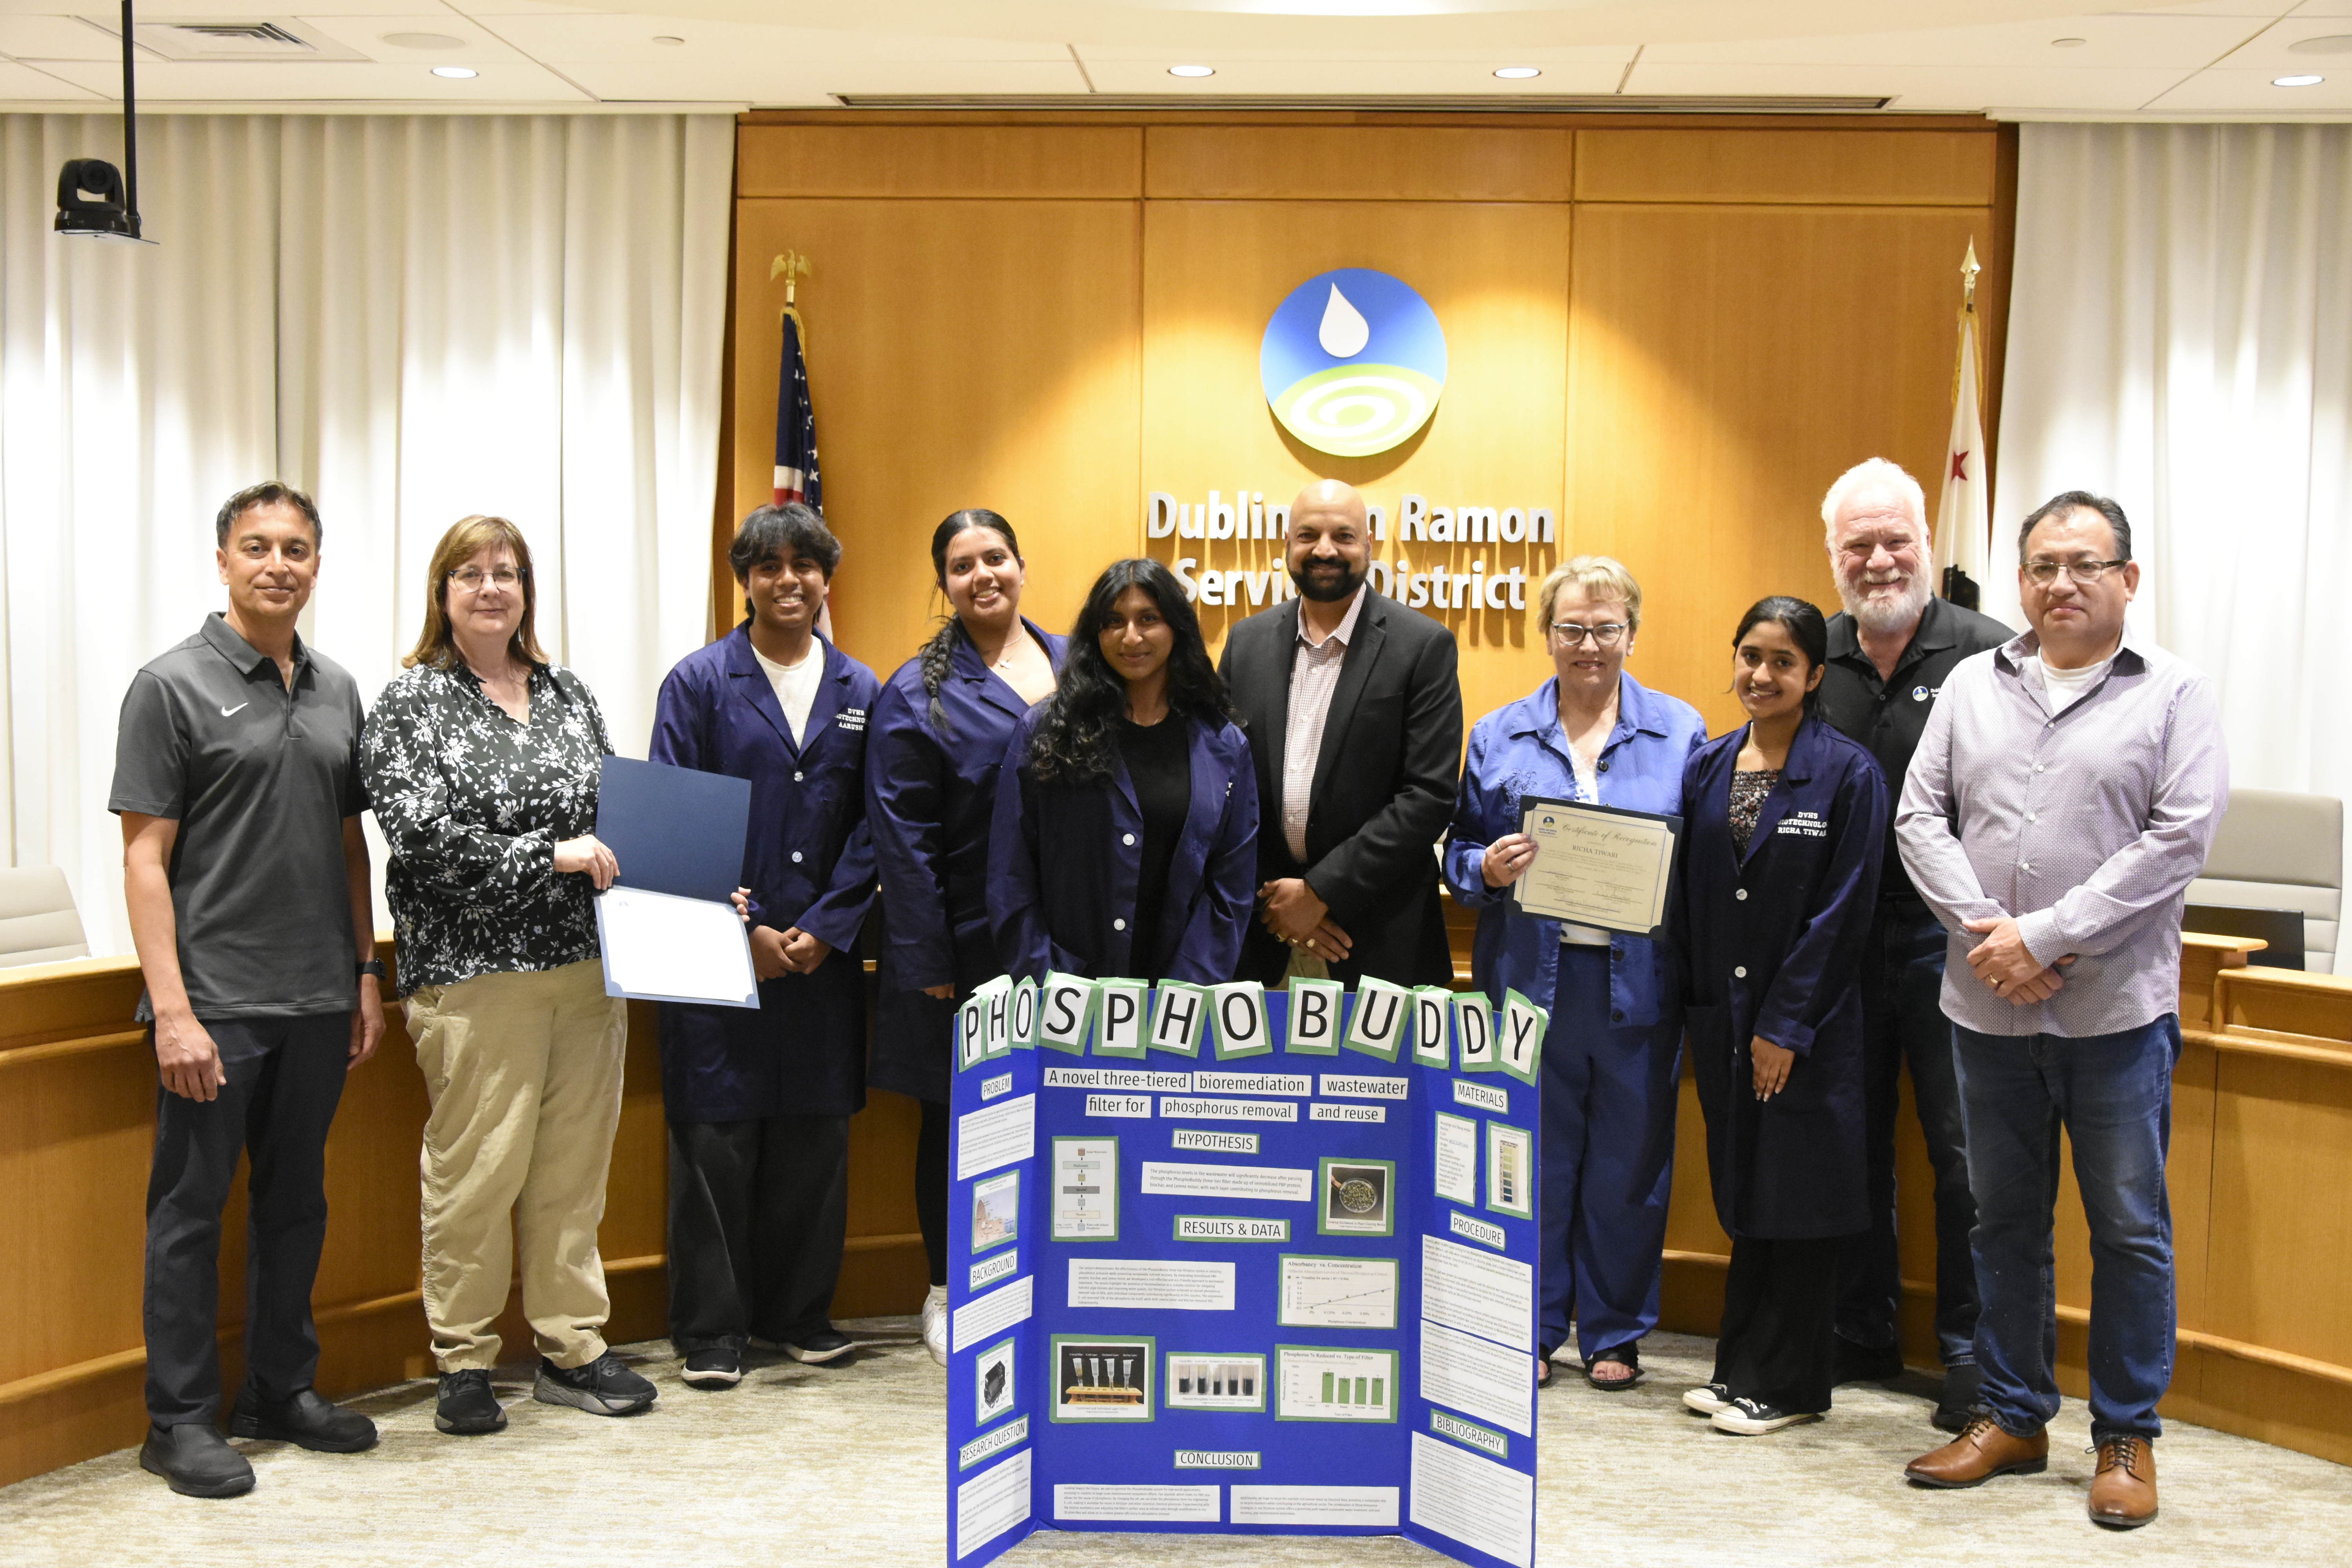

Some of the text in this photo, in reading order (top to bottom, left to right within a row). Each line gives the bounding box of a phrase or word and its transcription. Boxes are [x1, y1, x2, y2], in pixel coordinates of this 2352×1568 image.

[1148, 490, 1290, 539] Dublin
[1401, 494, 1554, 543] Ramon
[1175, 558, 1526, 610] Servi District
[848, 708, 864, 716] DVHS
[838, 721, 863, 731] AARUSH
[1562, 823, 1599, 837] Certificate
[1601, 831, 1612, 841] of
[1611, 833, 1657, 846] Recognition
[1777, 818, 1828, 828] BIOTECHNOLO
[1572, 845, 1618, 858] RICHA TIWARI
[983, 1077, 1010, 1096] PROBLEM
[1049, 1070, 1405, 1094] A novel three-tiered bioremediation wastewater
[1458, 1084, 1504, 1108] MATERIALS
[1089, 1097, 1378, 1120] filter for phosphorus removal and reuse
[1178, 1132, 1253, 1150] HYPOTHESIS
[1184, 1221, 1281, 1236] RESULTS & DATA
[1454, 1218, 1501, 1244] PROCEDURE
[972, 1255, 1014, 1283] BACKGROUND
[962, 1421, 1025, 1463] RESEARCH QUESTION
[1437, 1416, 1501, 1450] BIBLIOGRAPHY
[1180, 1452, 1253, 1466] CONCLUSION
